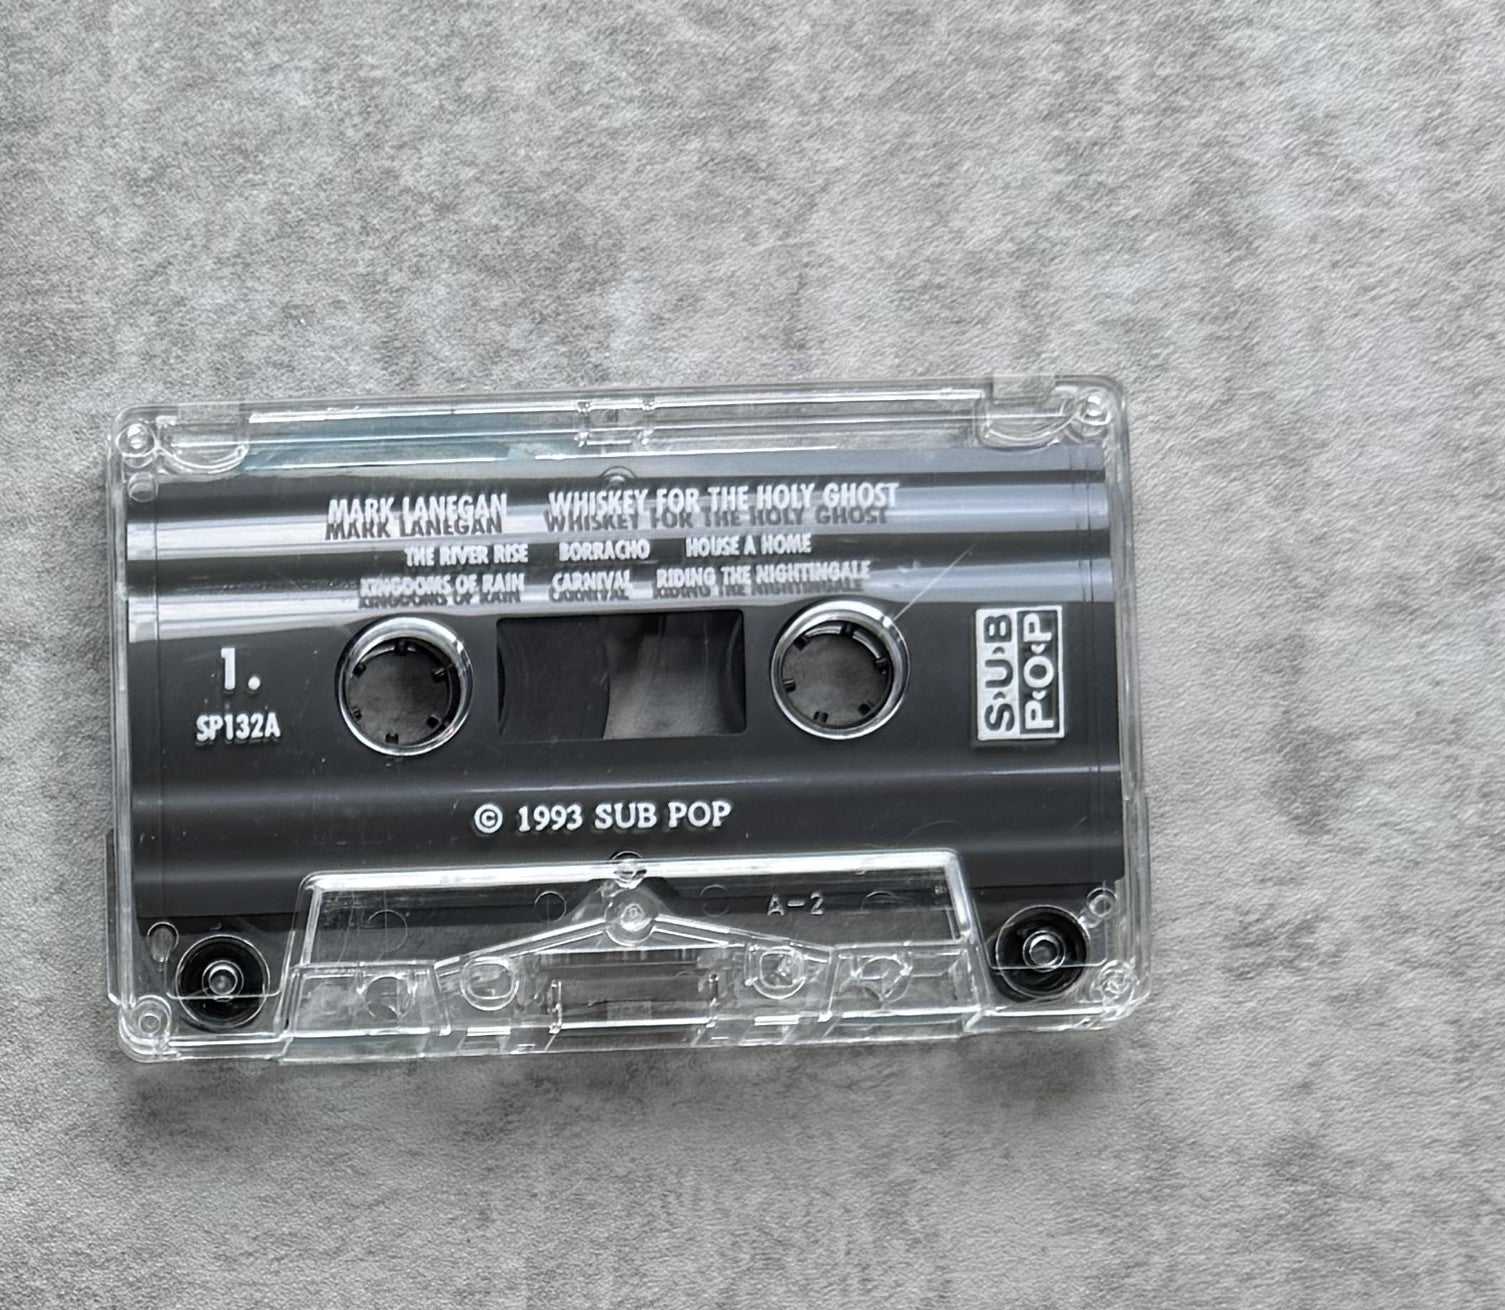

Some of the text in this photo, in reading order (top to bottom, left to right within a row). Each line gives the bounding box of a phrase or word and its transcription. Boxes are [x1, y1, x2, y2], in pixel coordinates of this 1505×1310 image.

[327, 482, 900, 524] MARK LANEGAN WHISKEY FOR THE HOLY GHOST
[405, 532, 812, 567] THE RIVER RISE BORRACHO HOUSE A HOME
[359, 560, 872, 597] KINGDOMS OF RAIN CARNIVAL RIDING THE NIGHTINGALE
[220, 646, 262, 691] 1.
[195, 711, 282, 742] SP132A
[517, 803, 584, 832] 1993
[594, 801, 658, 830] SUB
[667, 800, 733, 828] POP
[766, 891, 826, 917] A-2
